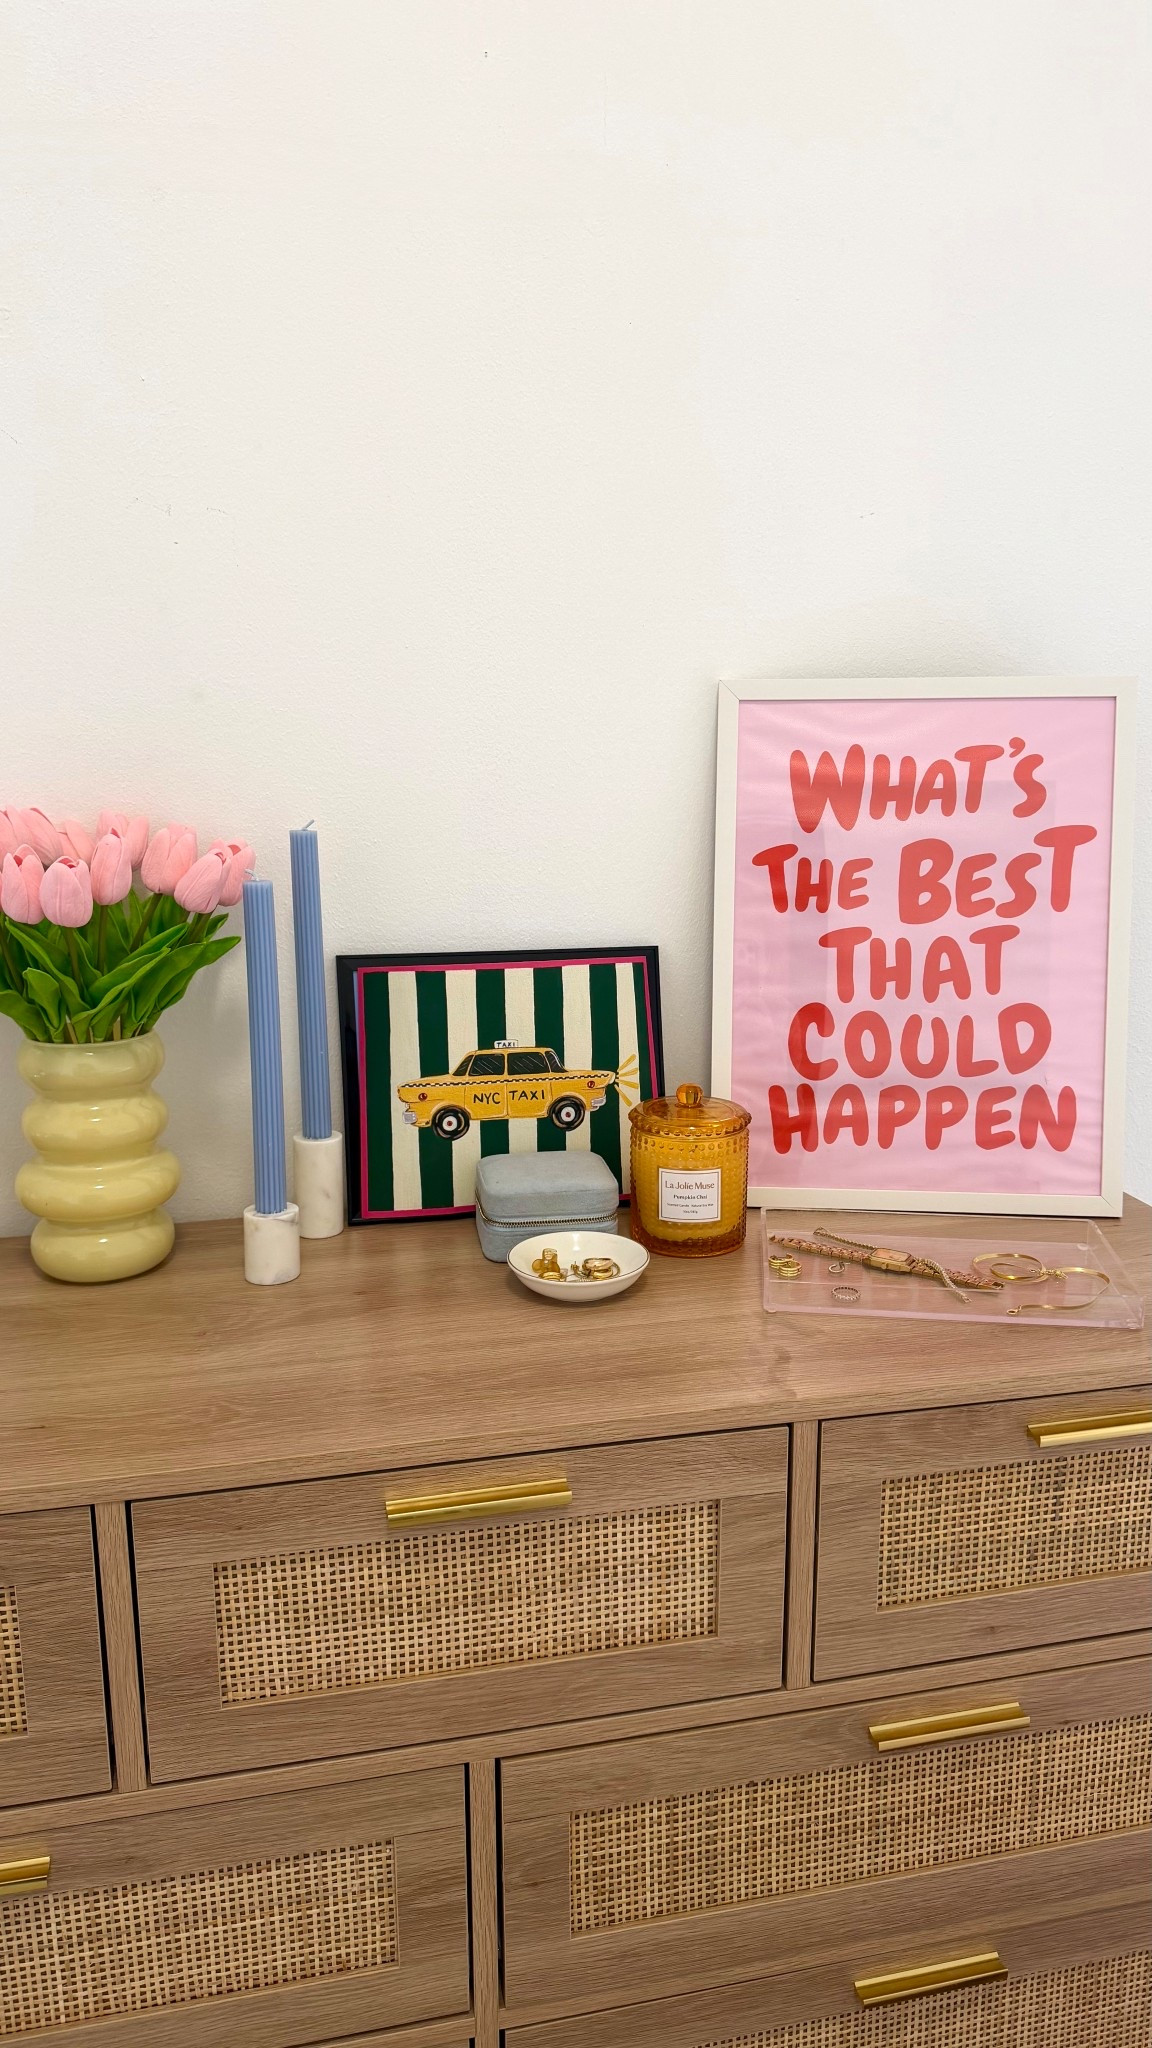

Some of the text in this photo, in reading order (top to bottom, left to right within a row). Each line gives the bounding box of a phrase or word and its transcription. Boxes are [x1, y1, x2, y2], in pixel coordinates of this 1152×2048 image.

[790, 737, 1047, 833] WHAT'S
[752, 825, 1097, 924] THE BEST
[819, 924, 1020, 1003] THAT
[788, 1002, 1052, 1081] COULD
[473, 1090, 545, 1104] NYC TAXI
[768, 1084, 1077, 1154] HAPPEN
[665, 1181, 674, 1189] La
[694, 1182, 714, 1190] Muse
